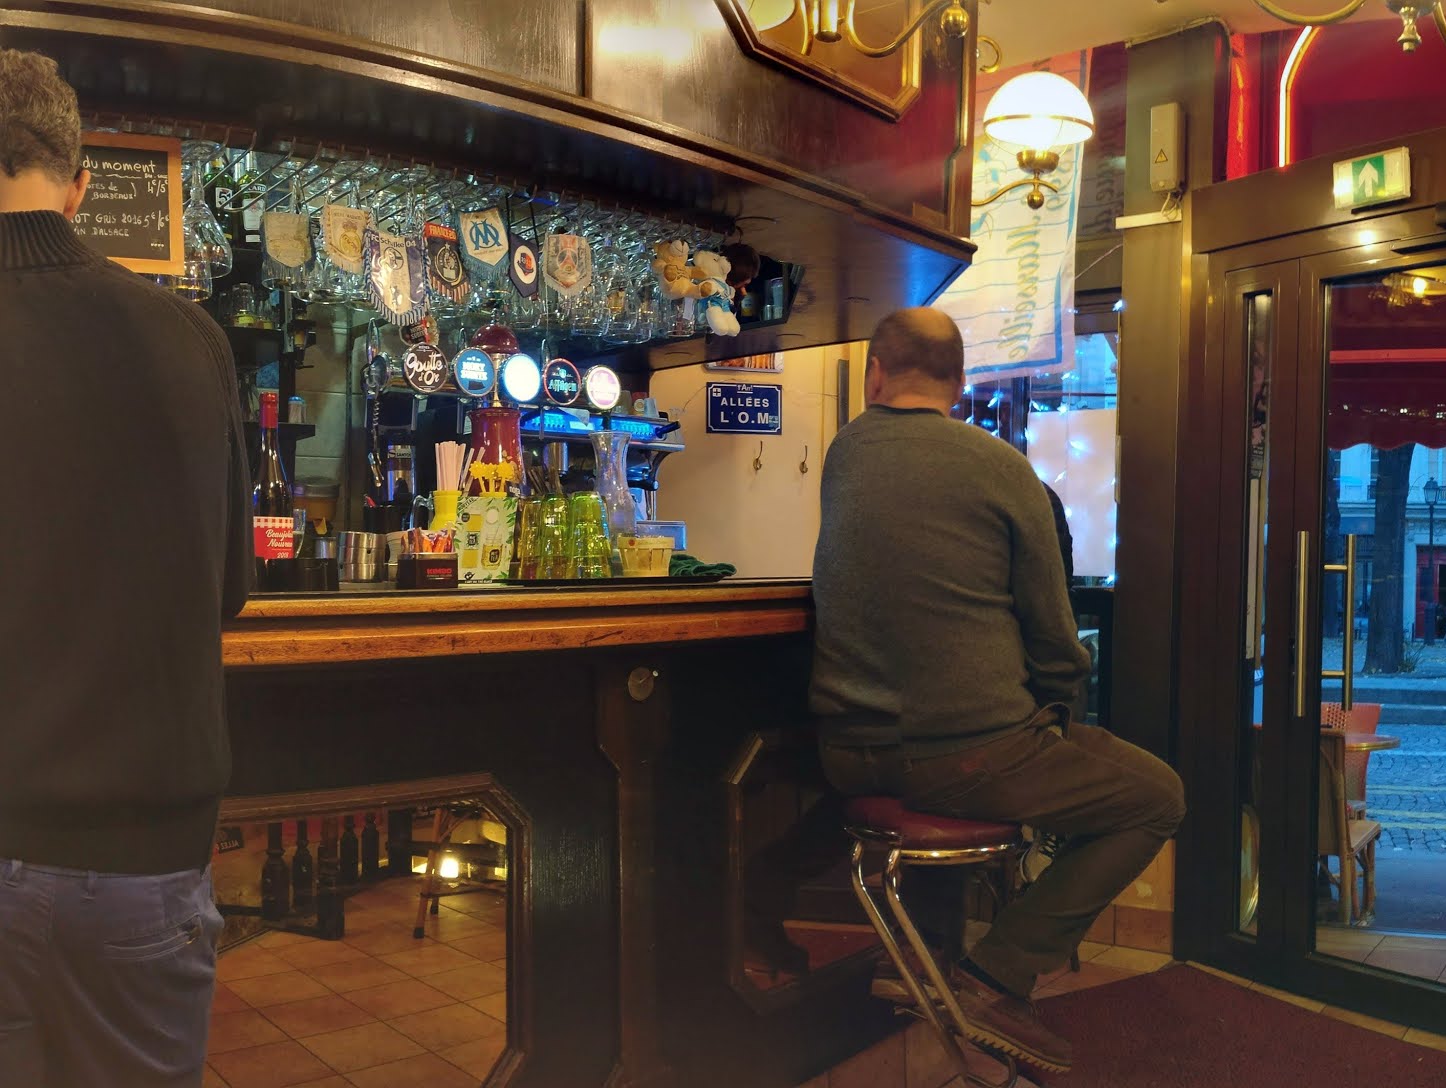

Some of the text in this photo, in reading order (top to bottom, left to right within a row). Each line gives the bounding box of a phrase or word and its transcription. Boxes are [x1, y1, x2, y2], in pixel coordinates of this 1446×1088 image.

[82, 155, 156, 173] du moment
[720, 397, 770, 408] ALLÉES
